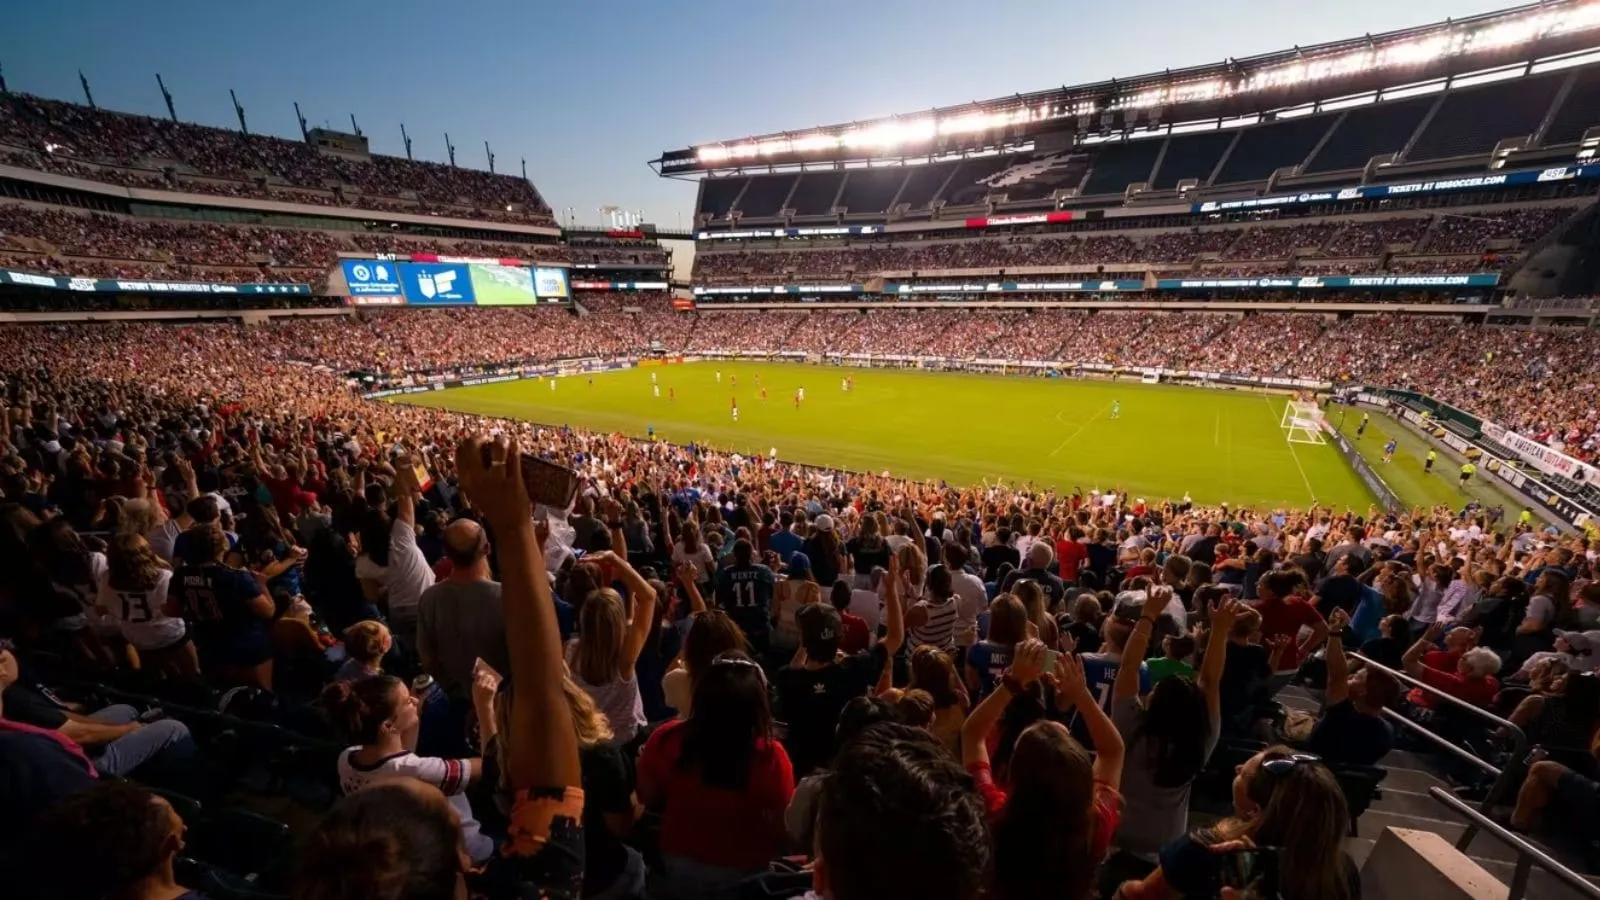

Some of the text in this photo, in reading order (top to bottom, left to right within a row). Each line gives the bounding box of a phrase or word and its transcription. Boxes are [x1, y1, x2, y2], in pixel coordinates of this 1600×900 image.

[1388, 174, 1507, 194] TICKETS AT USSOCCER.COM
[1348, 277, 1384, 286] TICKETS
[1384, 277, 1397, 285] AT
[1514, 438, 1573, 473] AMERICAN OUTLAWS
[731, 571, 758, 580] WENTZ
[732, 581, 758, 607] 11
[117, 591, 152, 623] 13
